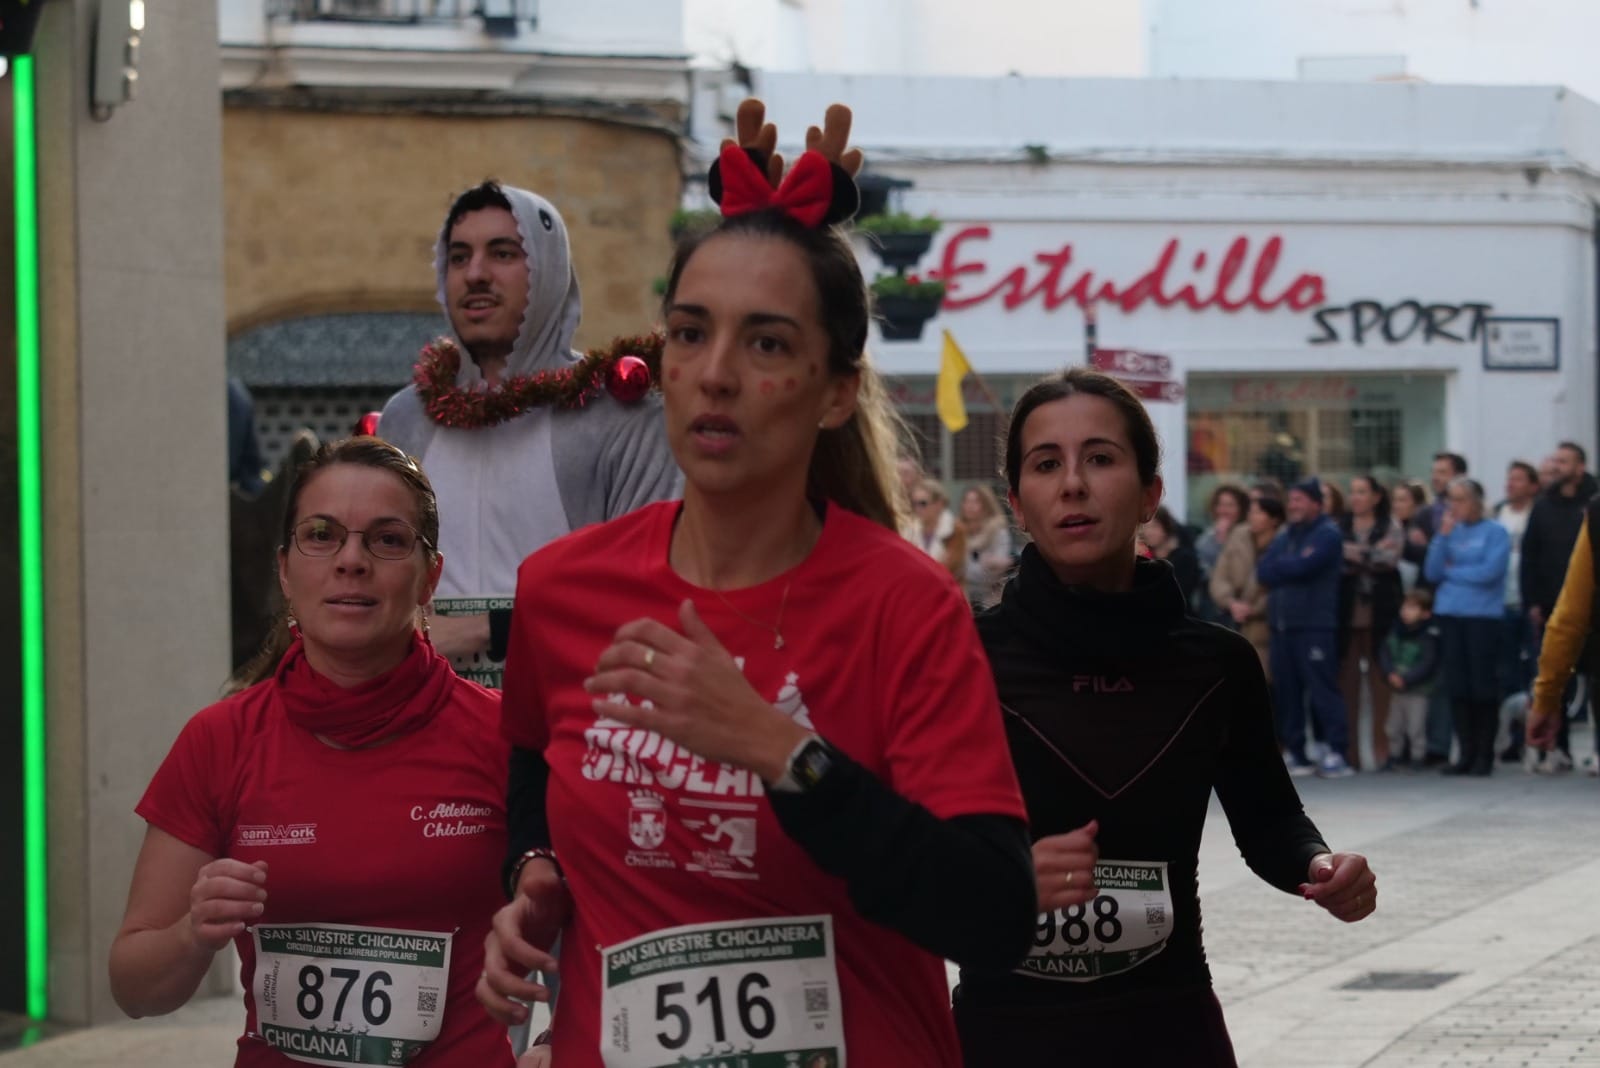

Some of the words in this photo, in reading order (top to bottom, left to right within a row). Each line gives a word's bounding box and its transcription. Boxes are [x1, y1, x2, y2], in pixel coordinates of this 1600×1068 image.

[939, 226, 1326, 313] Estudillo
[1307, 300, 1493, 346] SPORT
[1072, 675, 1134, 693] FILA
[410, 806, 428, 821] C.
[429, 803, 492, 818] Atletismo
[423, 821, 486, 838] Chiclana
[1034, 895, 1122, 946] 988
[263, 929, 291, 941] SAN
[296, 930, 355, 946] SILVESTRE
[358, 934, 441, 953] CHICLANERA
[333, 946, 342, 955] DE
[379, 950, 418, 962] POPULARES
[611, 947, 637, 970] SAN
[640, 933, 713, 959] SILVESTRE
[716, 925, 820, 948] CHICLANERA
[297, 965, 393, 1026] 876
[656, 972, 776, 1051] 516
[265, 1029, 349, 1057] CHICLANA
